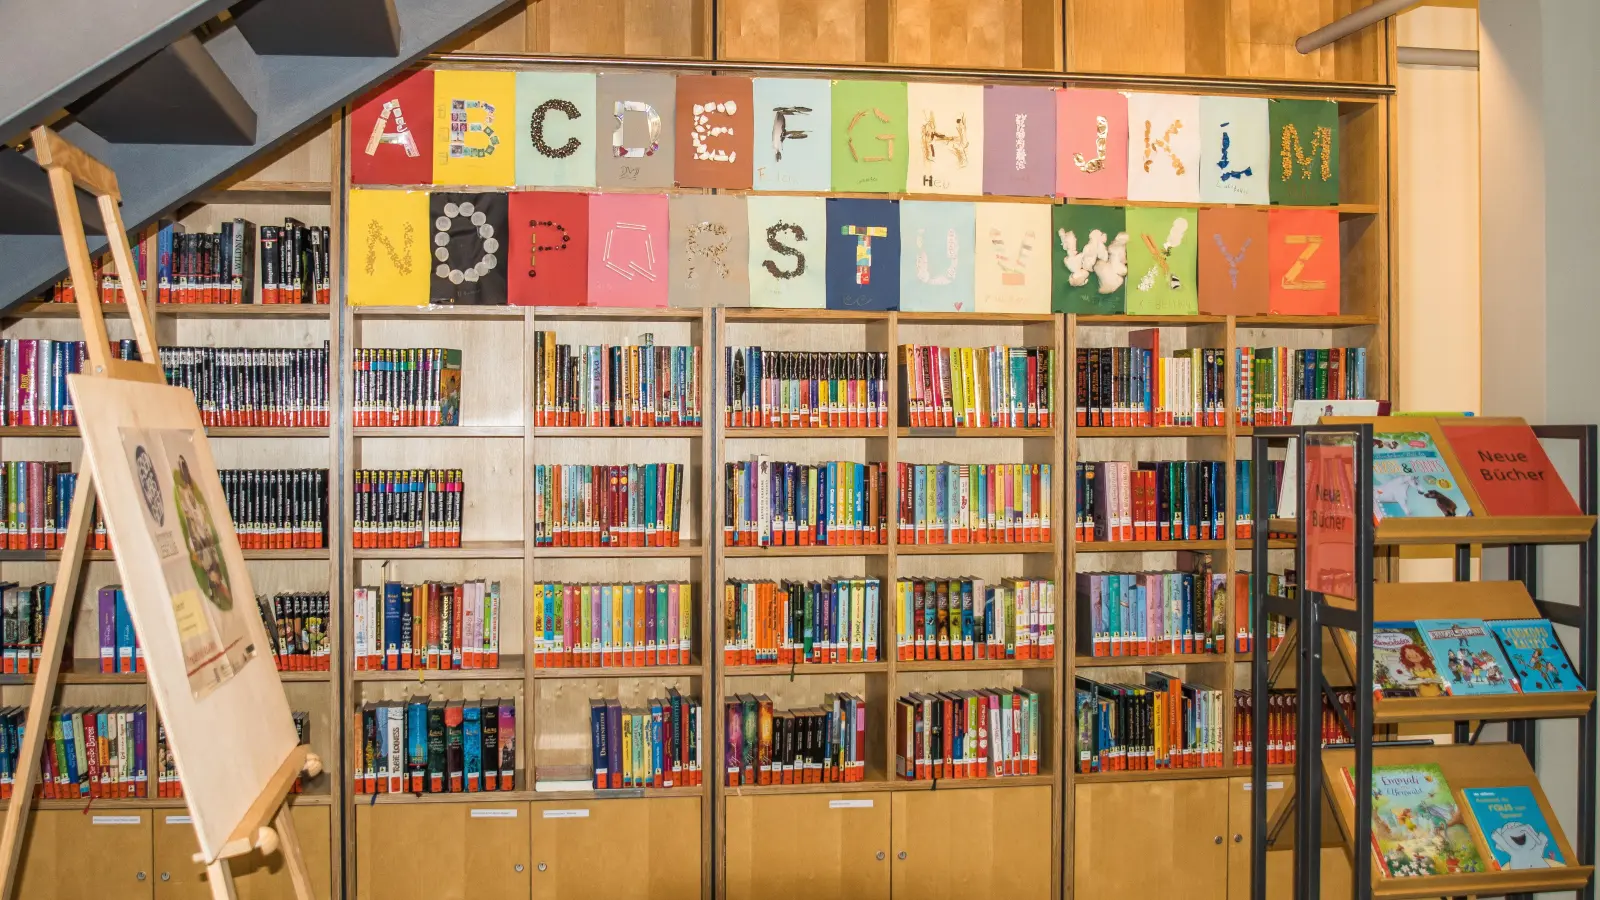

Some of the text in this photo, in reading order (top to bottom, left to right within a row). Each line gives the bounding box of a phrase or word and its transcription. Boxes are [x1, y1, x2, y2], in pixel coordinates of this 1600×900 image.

[365, 98, 421, 158] A
[450, 98, 501, 158] B
[530, 98, 582, 160] C
[611, 99, 662, 159] D
[691, 99, 738, 163] E
[770, 105, 814, 163] F
[846, 106, 897, 163] G
[920, 109, 971, 171] H
[1014, 112, 1029, 172] I
[1072, 115, 1110, 175] J
[1143, 119, 1185, 177] K
[1216, 122, 1254, 183] L
[1281, 121, 1333, 183] M
[234, 233, 243, 270] WILDNIS
[363, 217, 414, 277] N
[433, 200, 500, 286] O
[528, 218, 571, 279] P
[603, 220, 657, 282] Q
[685, 220, 731, 281] R
[761, 218, 810, 281] S
[840, 223, 889, 286] T
[915, 227, 960, 286] U
[988, 227, 1037, 287] V
[1057, 227, 1129, 295] W
[1136, 216, 1190, 293] X
[1211, 231, 1253, 291] Y
[1280, 233, 1328, 291] Z
[1402, 463, 1413, 474] &
[1477, 450, 1529, 464] Neue
[1479, 468, 1546, 483] Bücher
[1312, 510, 1346, 531] Bücher
[1316, 484, 1341, 502] Neue
